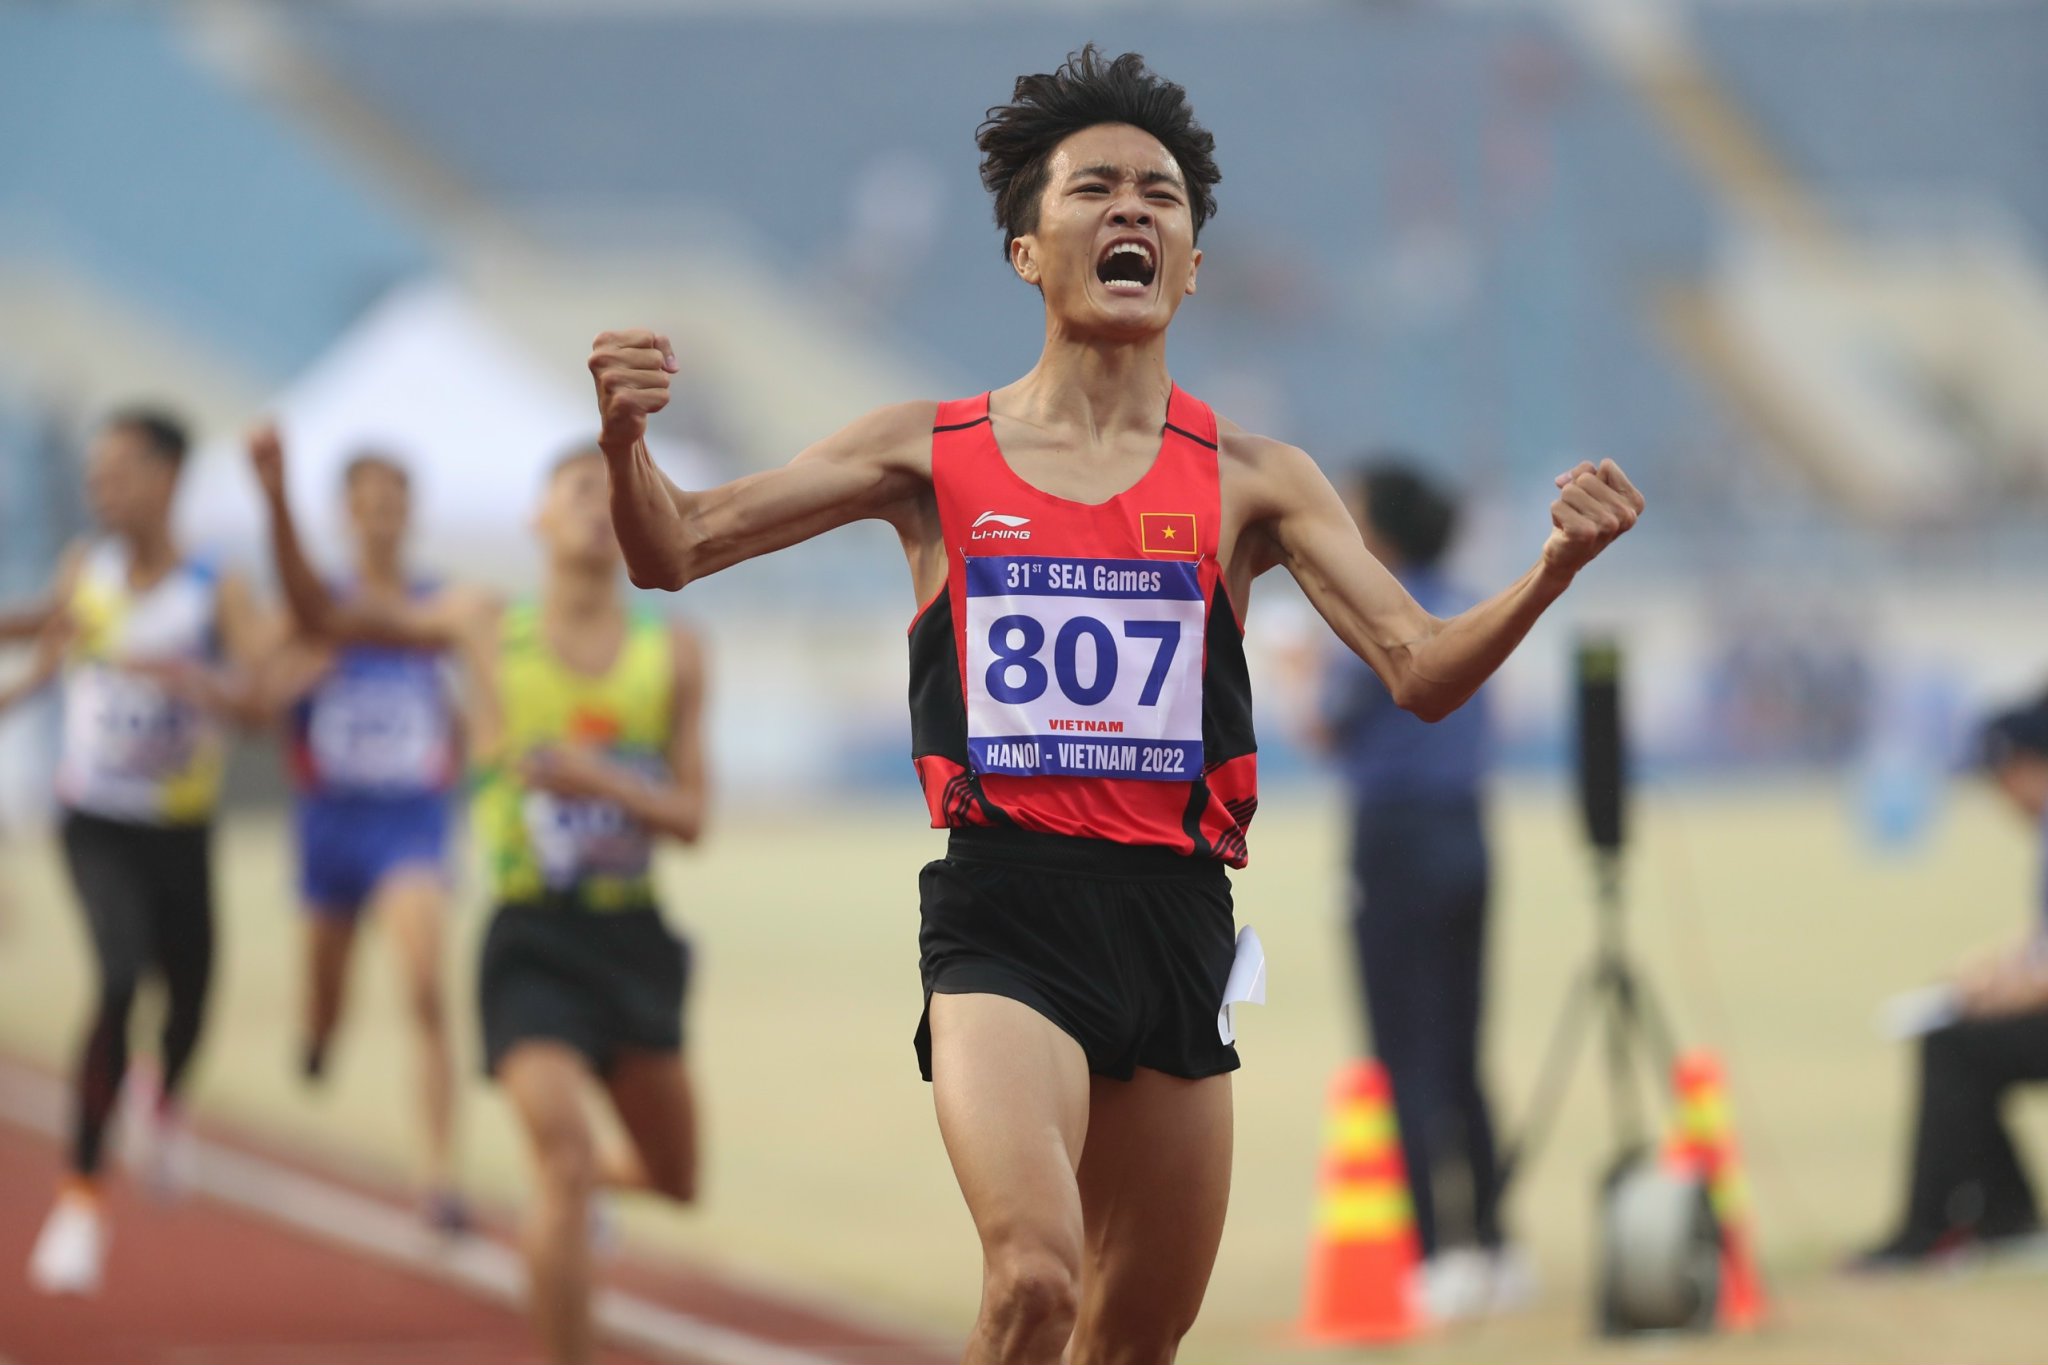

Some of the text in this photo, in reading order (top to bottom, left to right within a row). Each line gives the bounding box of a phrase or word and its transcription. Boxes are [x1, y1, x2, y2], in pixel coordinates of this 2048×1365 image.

[971, 530, 1031, 540] LI-NING
[1048, 563, 1087, 590] SEA
[1093, 566, 1161, 592] Games
[985, 614, 1181, 707] 807
[1048, 719, 1124, 733] VIETNAM
[986, 743, 1040, 768] HANOI
[1058, 743, 1136, 772] VIETNAM
[1141, 747, 1185, 773] 2022
